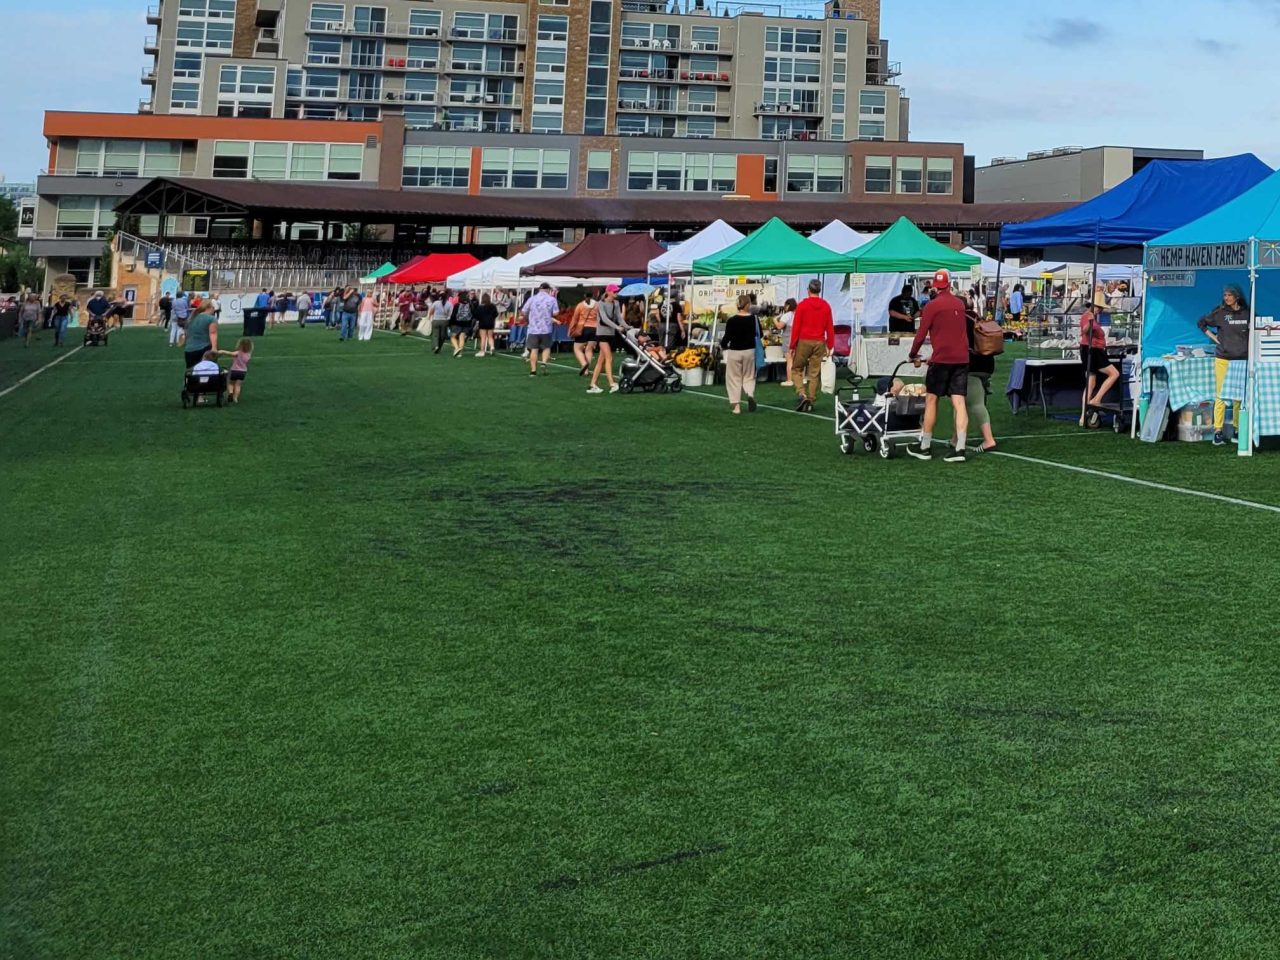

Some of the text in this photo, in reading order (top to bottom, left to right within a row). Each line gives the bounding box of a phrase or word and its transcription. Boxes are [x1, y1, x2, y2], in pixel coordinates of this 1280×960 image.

[1160, 244, 1245, 267] HEMP HAVEN FARMS
